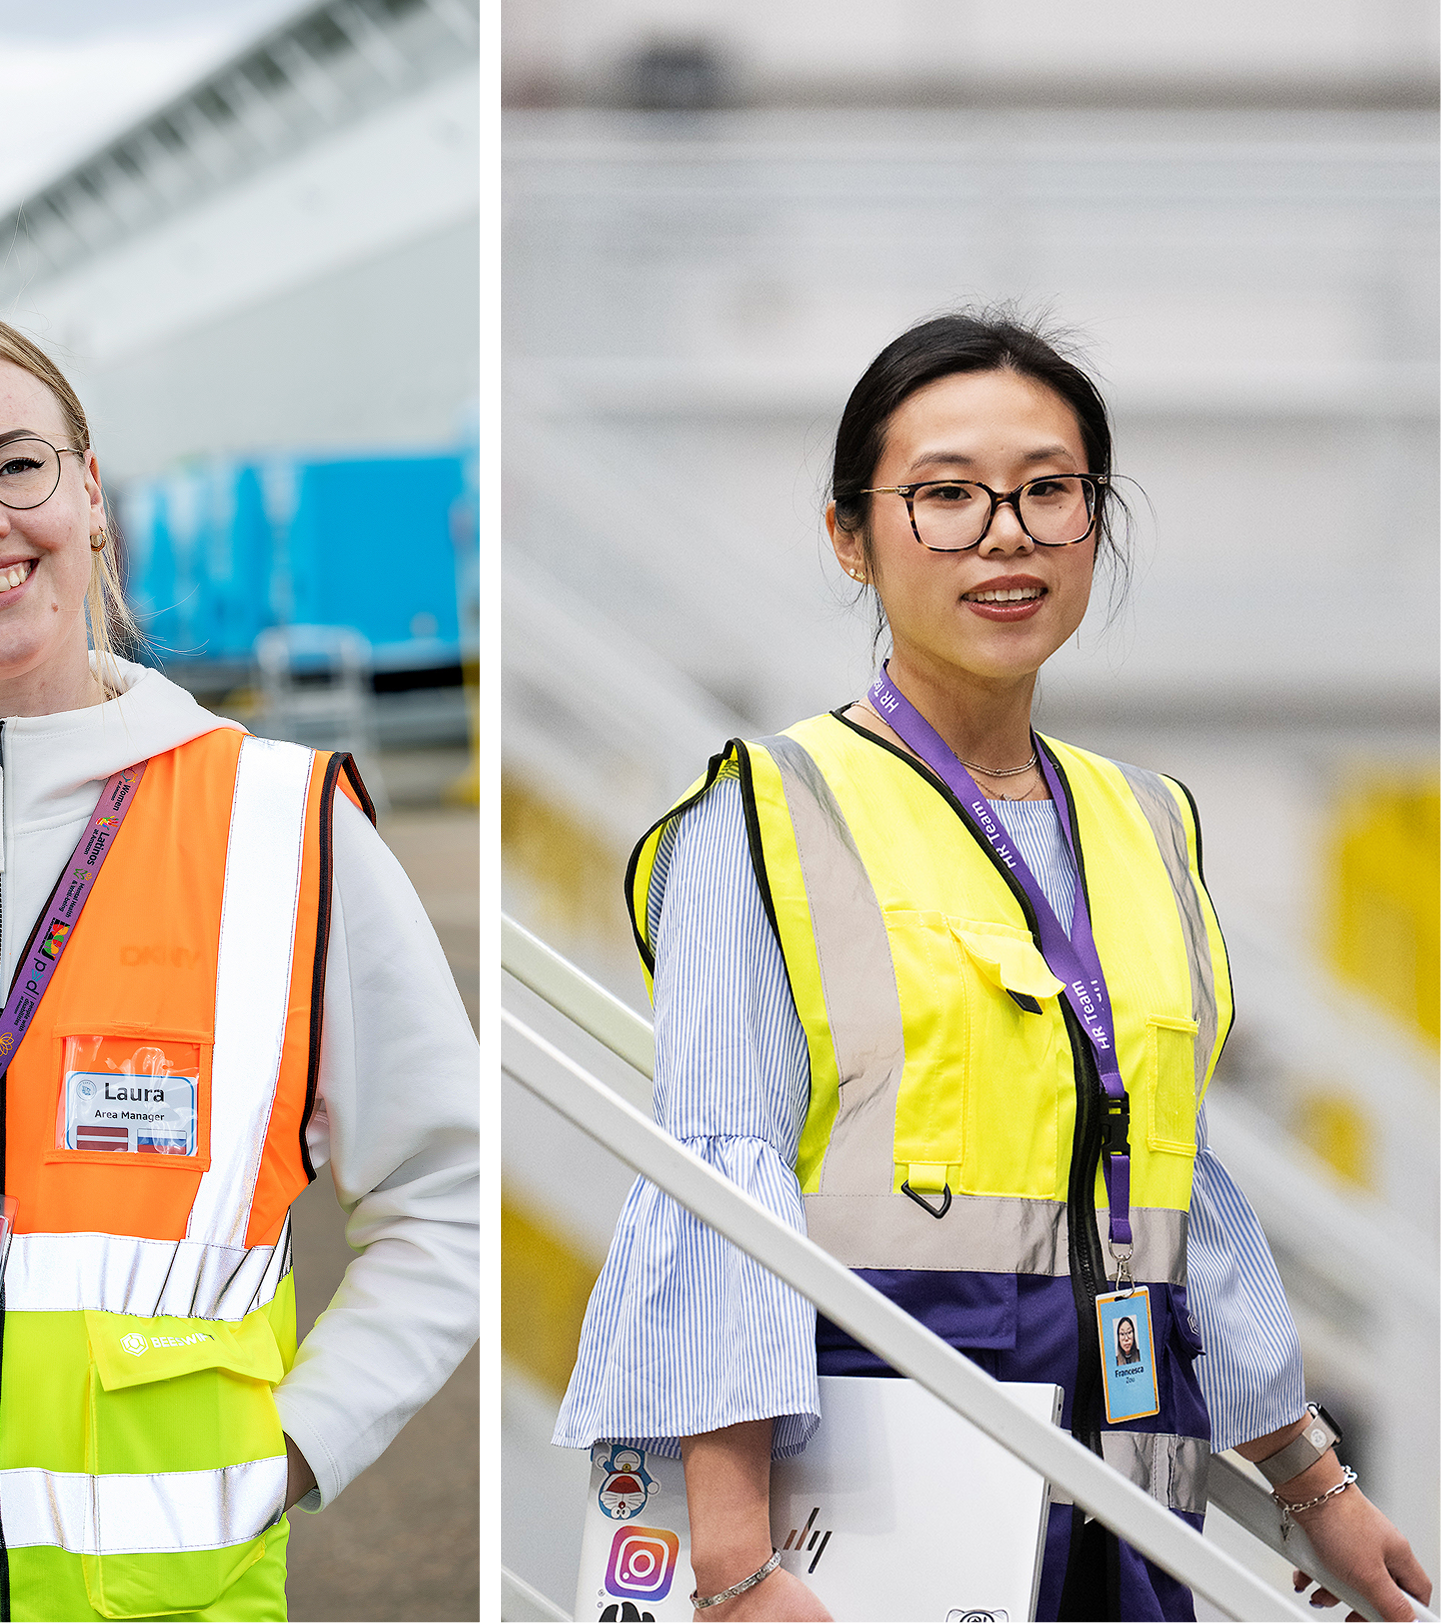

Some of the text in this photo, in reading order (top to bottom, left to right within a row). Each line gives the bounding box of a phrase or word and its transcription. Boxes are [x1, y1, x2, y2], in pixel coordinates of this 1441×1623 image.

[880, 690, 899, 713] HR
[113, 783, 131, 812] Women
[83, 834, 98, 855] Amazon
[971, 801, 1017, 869] HR Team
[87, 831, 110, 866] Latinos
[65, 899, 77, 918] Health
[1071, 980, 1098, 1025] Team
[1091, 1025, 1110, 1050] HR
[104, 1081, 165, 1103] Laura
[94, 1109, 165, 1122] Area Manager
[150, 1332, 215, 1348] BEESWIF
[1114, 1366, 1145, 1378] Francesca
